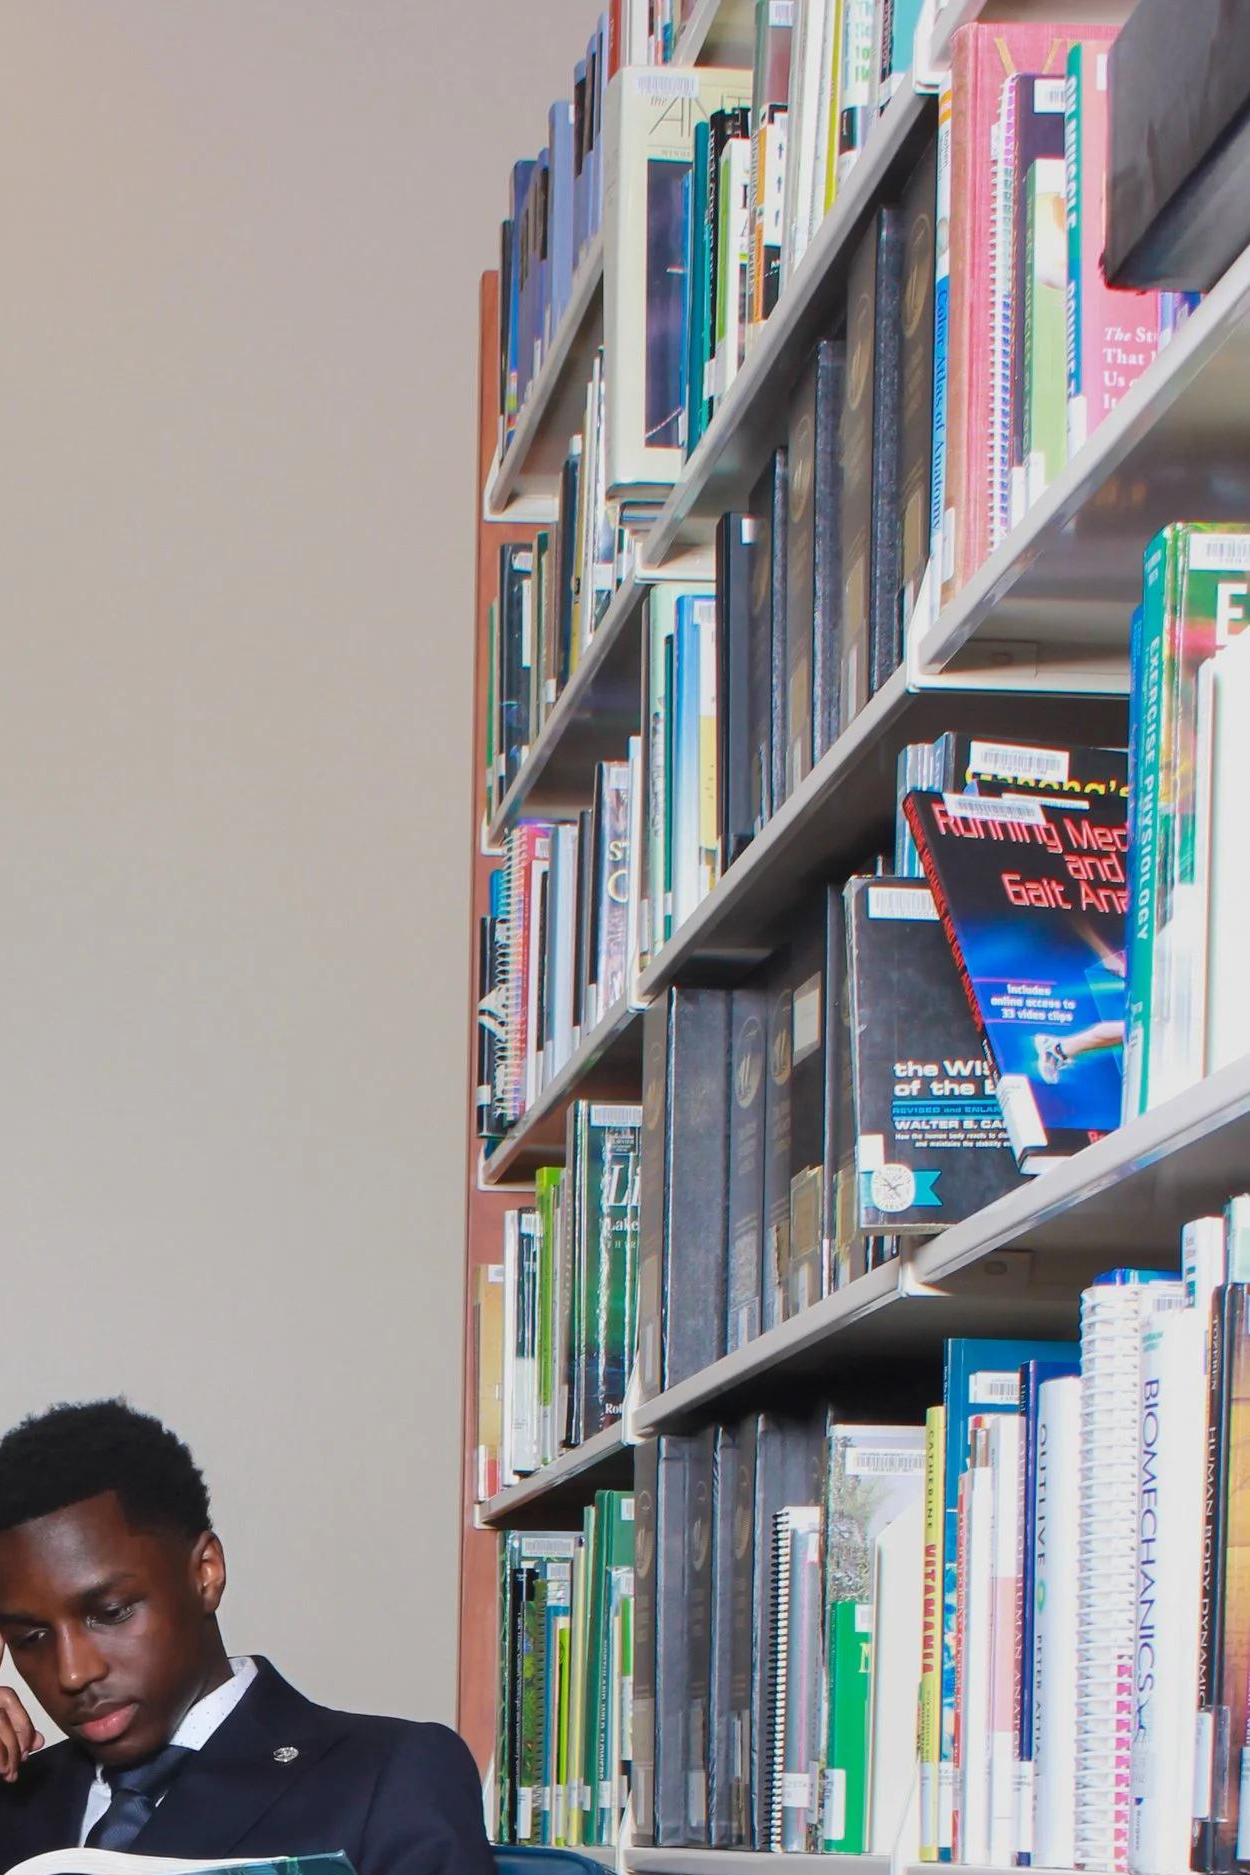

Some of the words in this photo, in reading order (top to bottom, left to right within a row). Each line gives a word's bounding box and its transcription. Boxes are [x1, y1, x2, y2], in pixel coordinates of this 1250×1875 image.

[936, 290, 947, 344] Color
[1105, 327, 1131, 342] The
[1103, 346, 1144, 365] That
[936, 354, 946, 407] Atlas
[1104, 369, 1125, 388] Us
[934, 411, 945, 431] of
[931, 438, 943, 529] Anatomy
[1144, 638, 1160, 766] EXERCISE
[1065, 854, 1123, 883] and
[1137, 776, 1157, 939] PHYSIOLOGY
[1001, 873, 1069, 909] Gait
[990, 995, 1024, 1008] online
[1026, 997, 1060, 1010] access
[1063, 998, 1076, 1010] to
[1007, 984, 1051, 997] Includes
[1001, 1008, 1015, 1020] 33
[1017, 1009, 1045, 1021] video
[1047, 1010, 1073, 1024] clips
[893, 1060, 939, 1078] the
[894, 1079, 921, 1096] of
[930, 1079, 976, 1096] the
[892, 1105, 941, 1114] REVISED
[943, 1105, 962, 1113] and
[894, 1119, 960, 1130] WALTER
[911, 1131, 922, 1140] the
[948, 1131, 964, 1141] body
[988, 1132, 995, 1140] to
[914, 1140, 927, 1148] and
[962, 1140, 973, 1148] the
[927, 1429, 935, 1530] CATHERINE
[1204, 1426, 1217, 1517] HUMAN
[1037, 1423, 1048, 1568] OUTLIVE
[1136, 1378, 1160, 1695] BIOMECHANICS
[1202, 1525, 1213, 1591] BODY
[922, 1543, 937, 1676] VITAMANIA
[1035, 1635, 1043, 1691] PETER
